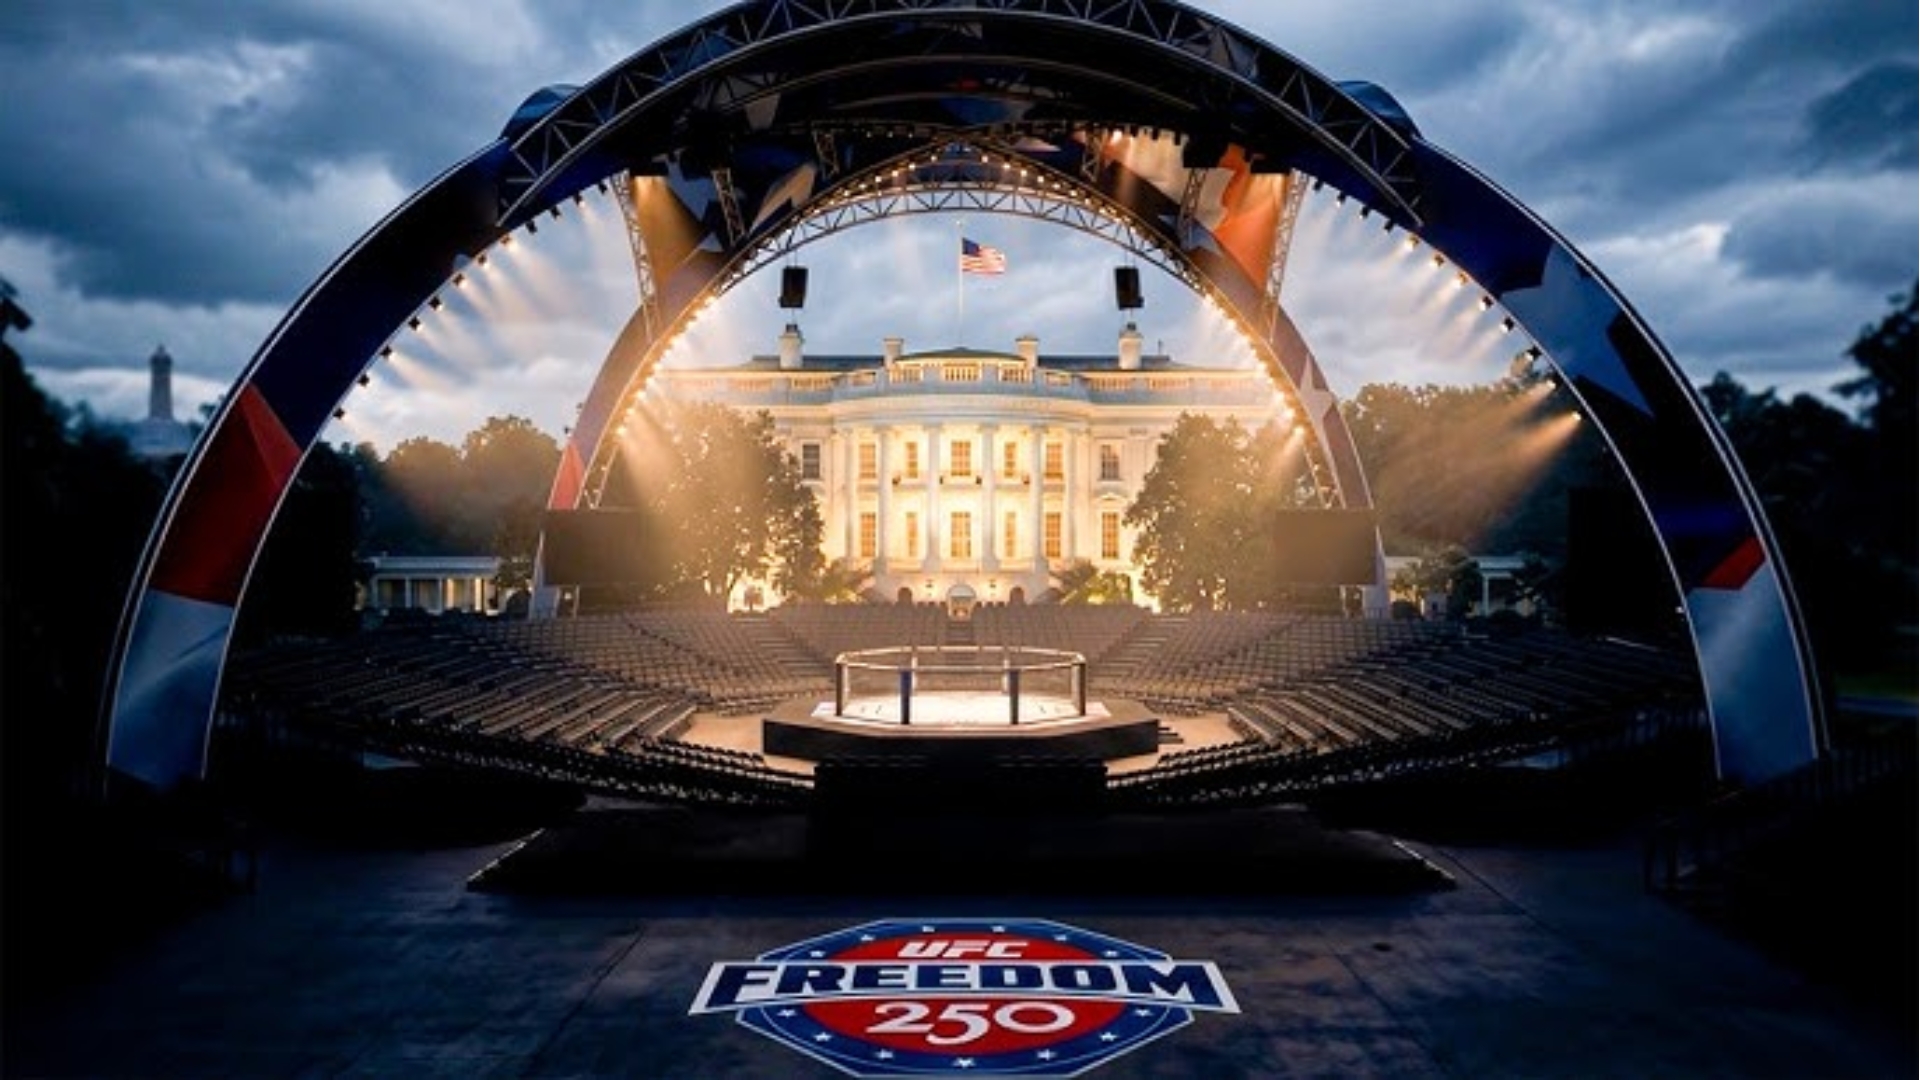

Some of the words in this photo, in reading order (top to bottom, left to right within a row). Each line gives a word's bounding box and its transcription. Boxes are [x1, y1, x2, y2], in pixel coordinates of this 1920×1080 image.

[897, 941, 1030, 959] UFC
[706, 964, 1223, 1007] FREEDOM
[865, 1001, 1076, 1045] 250
